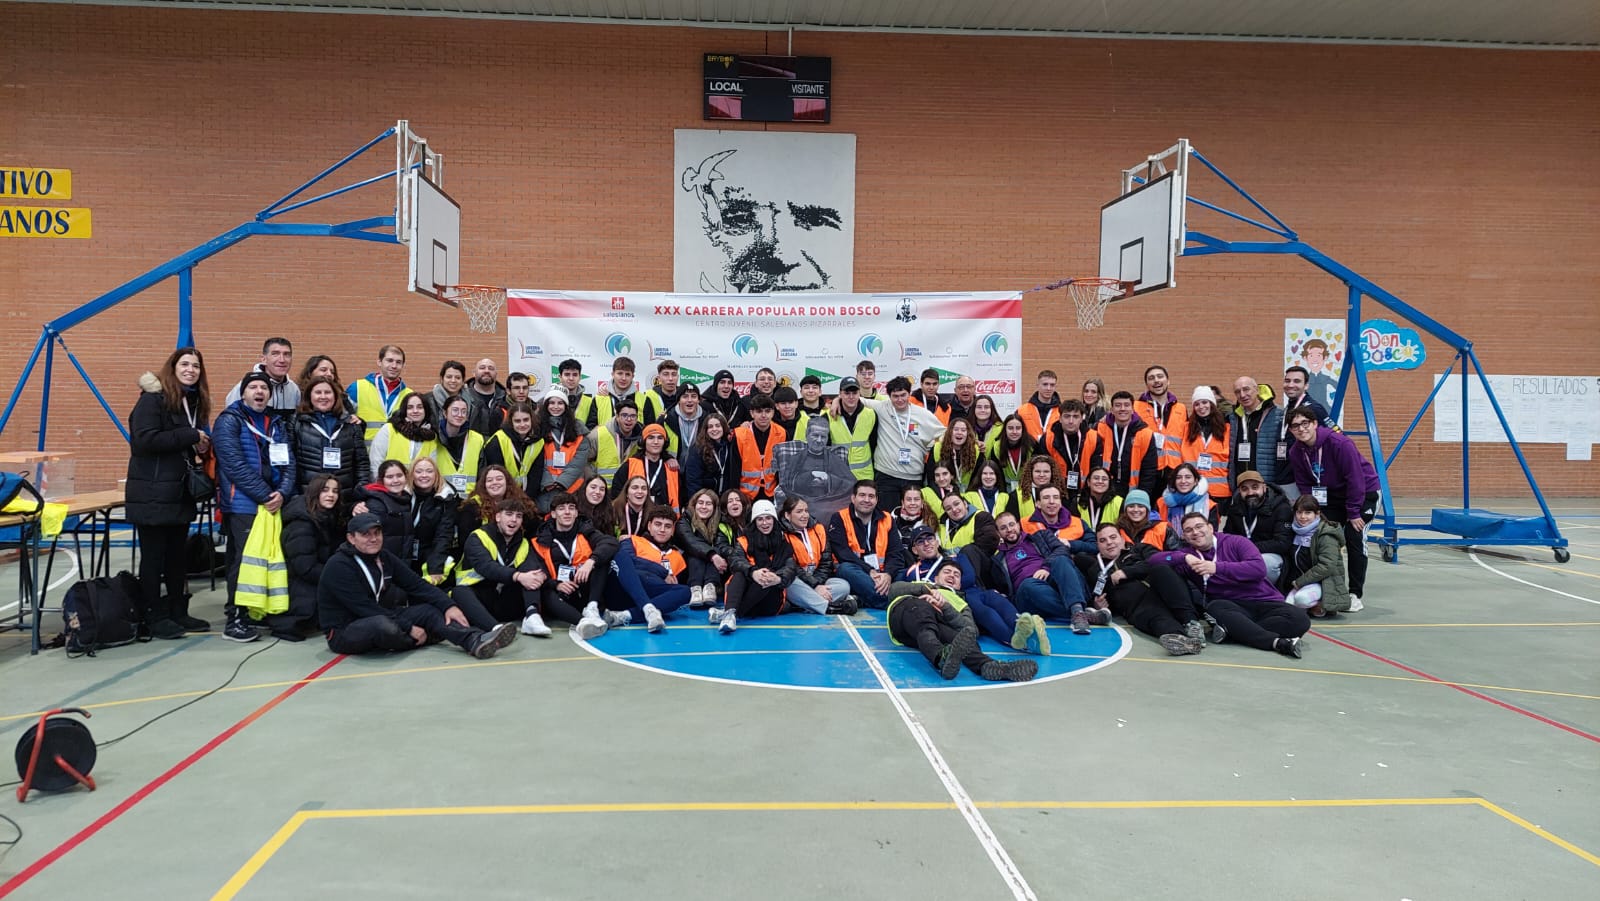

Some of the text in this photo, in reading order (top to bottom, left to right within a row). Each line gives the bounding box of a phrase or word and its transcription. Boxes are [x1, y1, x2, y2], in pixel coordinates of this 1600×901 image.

[710, 82, 743, 92] LOCAL
[792, 84, 824, 94] VISITANTE
[0, 210, 70, 234] ANOS
[654, 306, 880, 316] XXX CARRERA POPULAR DON BOSCO
[1362, 330, 1398, 349] Don
[1512, 378, 1588, 395] RESULTADOS
